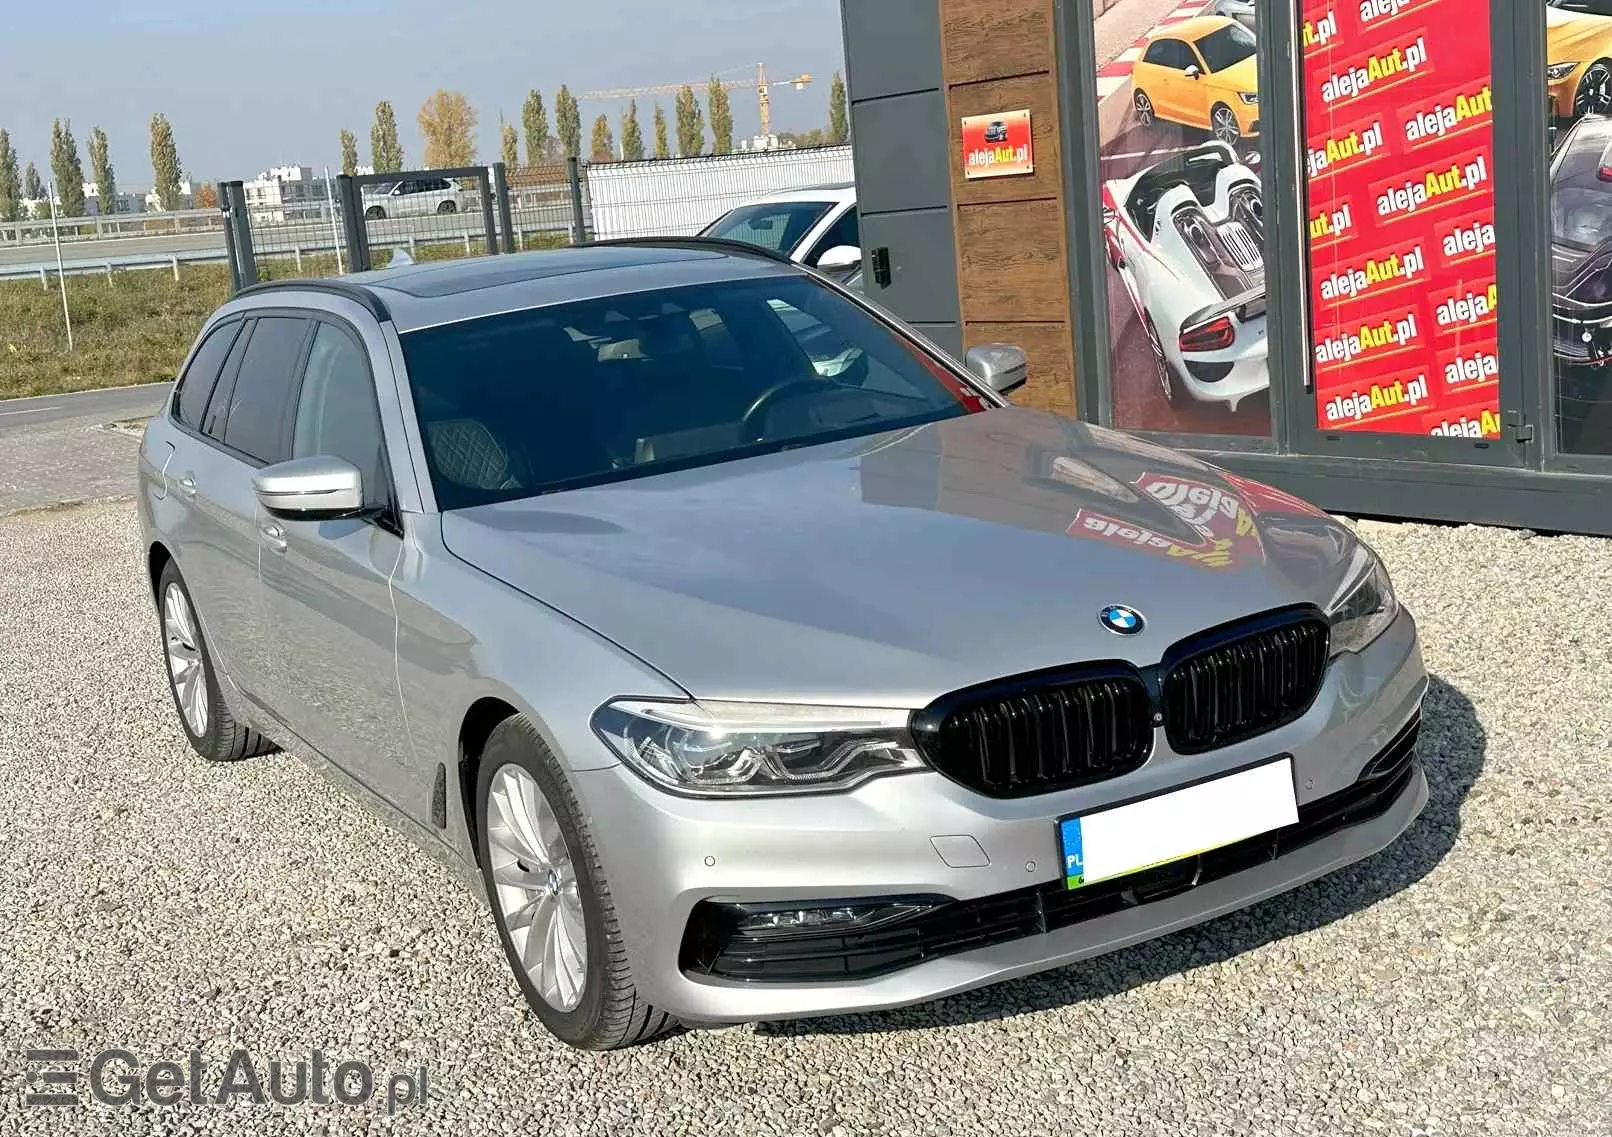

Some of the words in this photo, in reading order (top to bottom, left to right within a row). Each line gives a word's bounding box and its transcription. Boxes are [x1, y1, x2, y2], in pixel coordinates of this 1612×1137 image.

[1320, 36, 1427, 103] alejaAut.pl
[1405, 86, 1492, 140] alejaAut
[968, 144, 1028, 168] alejaAut.pl
[1376, 155, 1487, 216] alejaAut.pl
[1443, 221, 1495, 257] aleja
[1320, 245, 1424, 299] alejaAut.pl
[1315, 312, 1417, 363] alejaAut.pl
[1325, 374, 1428, 420] alejaAut.pl
[1067, 854, 1083, 868] PL
